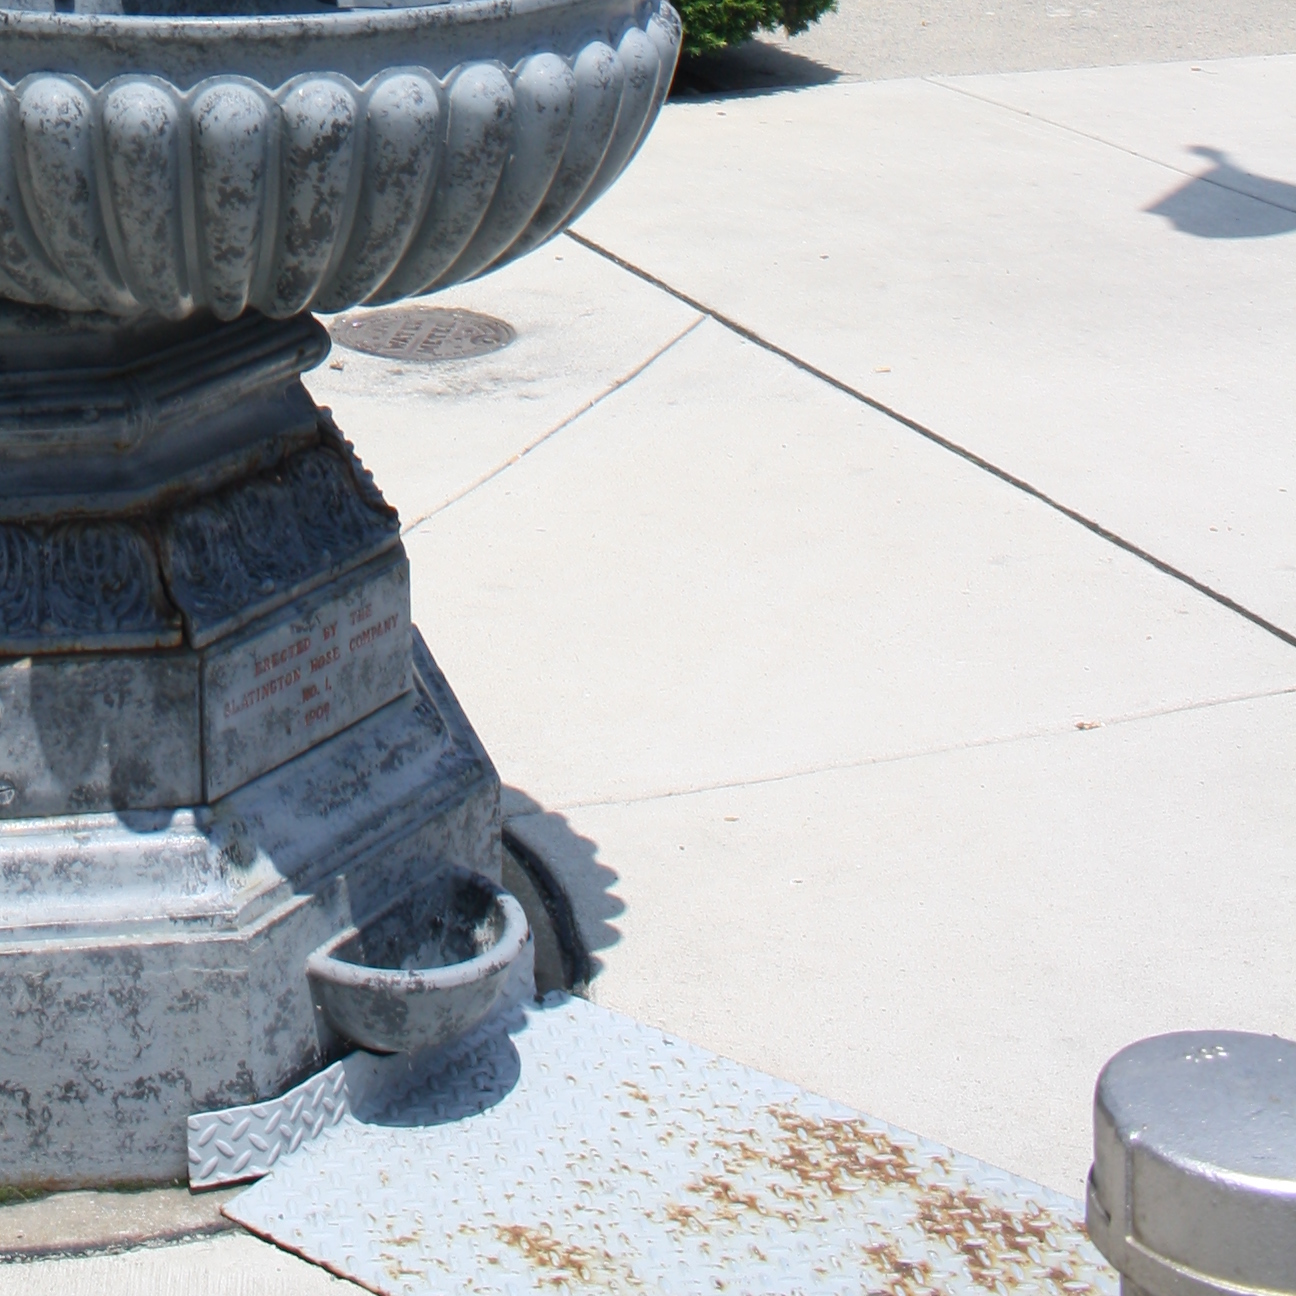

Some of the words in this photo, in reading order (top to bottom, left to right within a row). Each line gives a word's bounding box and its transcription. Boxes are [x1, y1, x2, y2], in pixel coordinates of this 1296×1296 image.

[224, 666, 301, 718] SLATINGTON
[310, 647, 341, 673] HOSE
[349, 613, 399, 652] COMPANY
[254, 637, 311, 676] ERECTED
[322, 620, 338, 641] BY
[349, 603, 373, 626] THE
